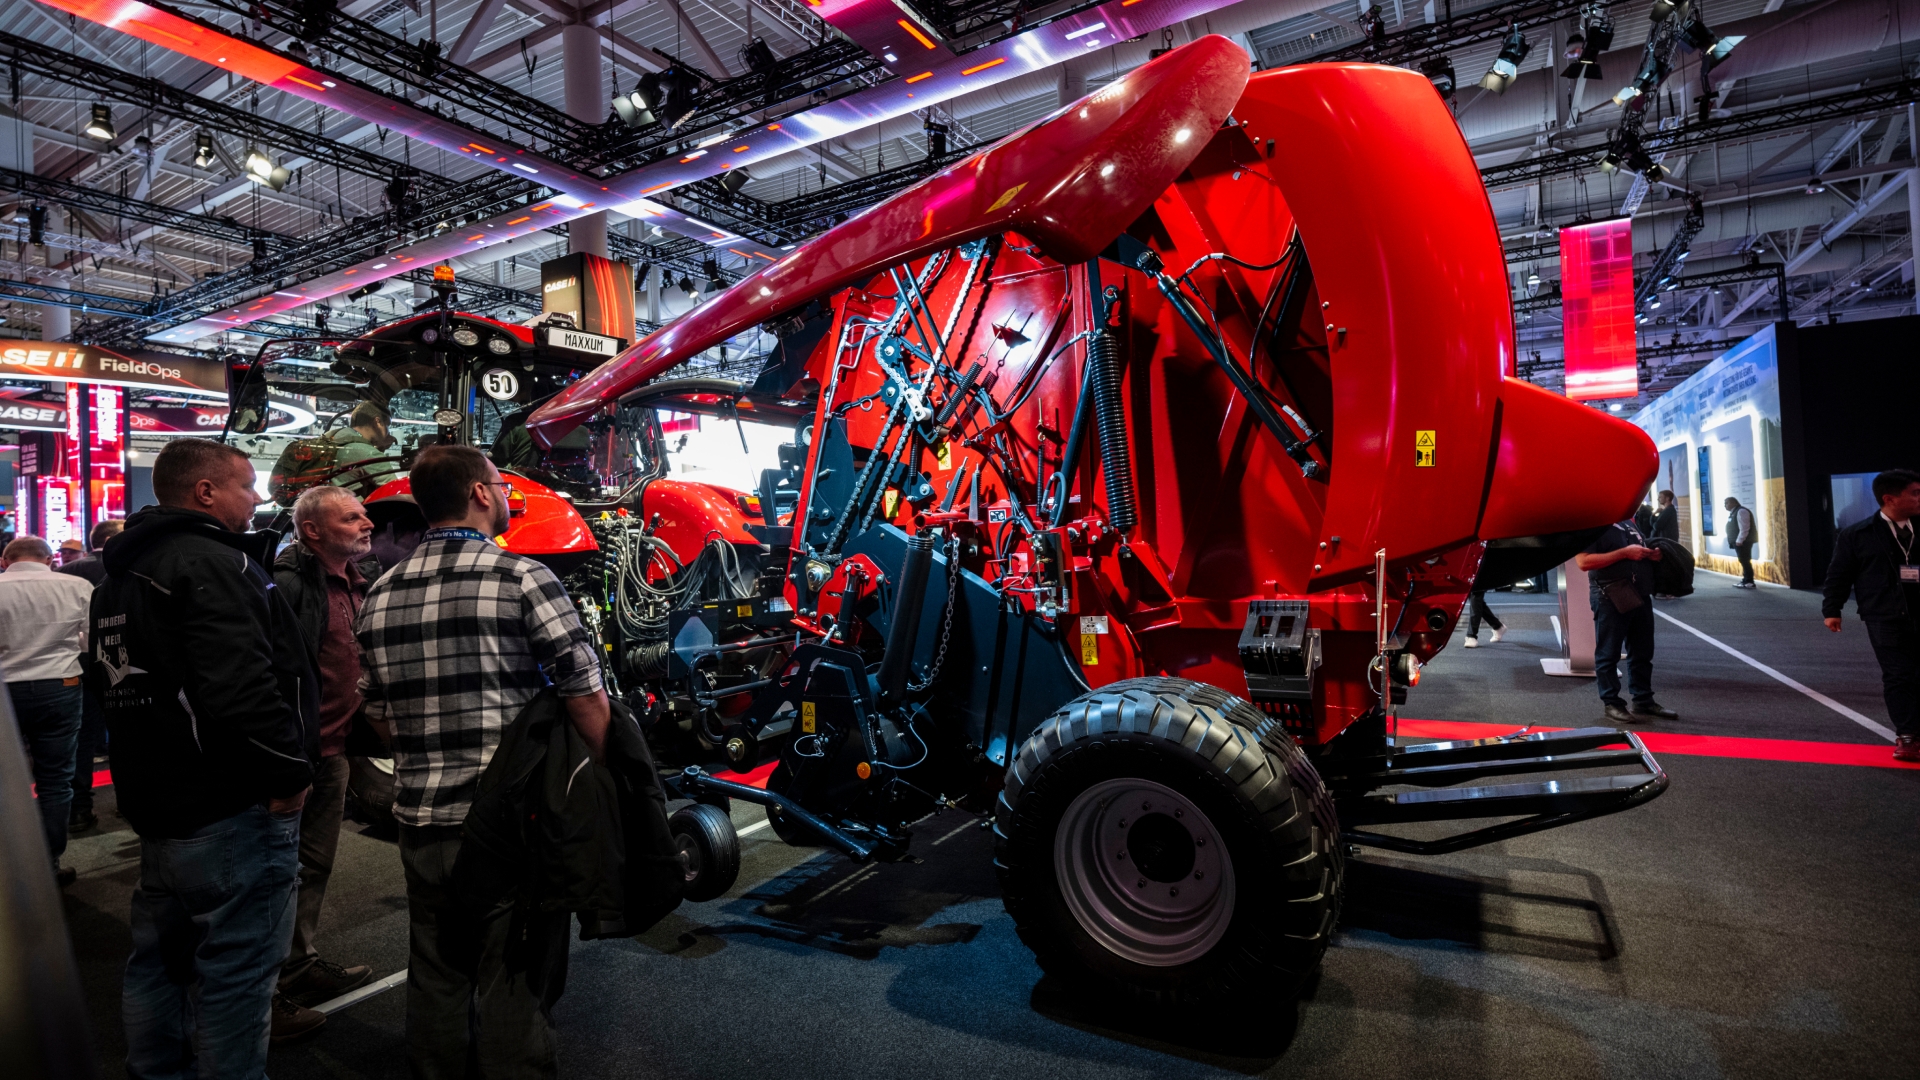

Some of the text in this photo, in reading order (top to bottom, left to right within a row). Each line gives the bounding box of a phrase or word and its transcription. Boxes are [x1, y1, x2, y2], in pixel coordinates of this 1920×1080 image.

[544, 280, 568, 293] CASE
[565, 333, 604, 352] MAXXUM
[0, 348, 52, 367] SE
[100, 358, 182, 380] FieldOps
[489, 374, 513, 394] 50
[196, 413, 230, 426] CAS
